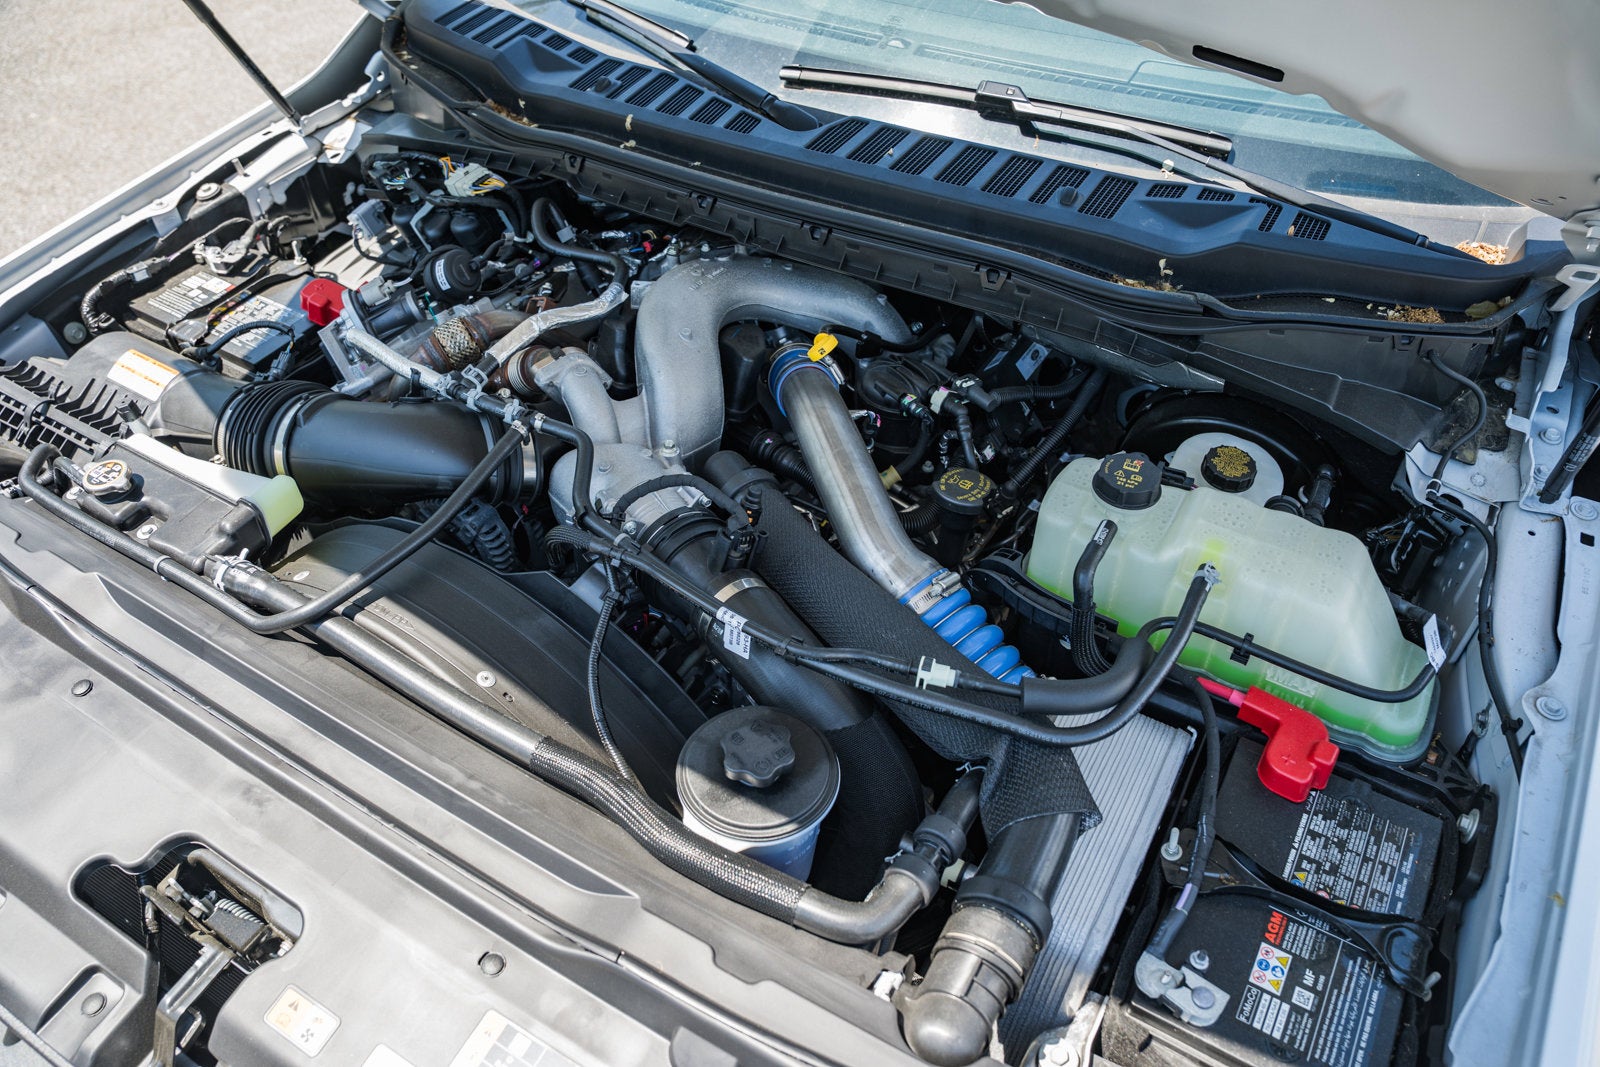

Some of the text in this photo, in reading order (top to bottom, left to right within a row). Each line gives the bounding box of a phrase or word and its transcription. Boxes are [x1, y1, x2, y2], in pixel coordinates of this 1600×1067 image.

[1264, 911, 1284, 944] AGM
[1303, 968, 1315, 987] MF
[1239, 987, 1257, 1023] FoMoCo
